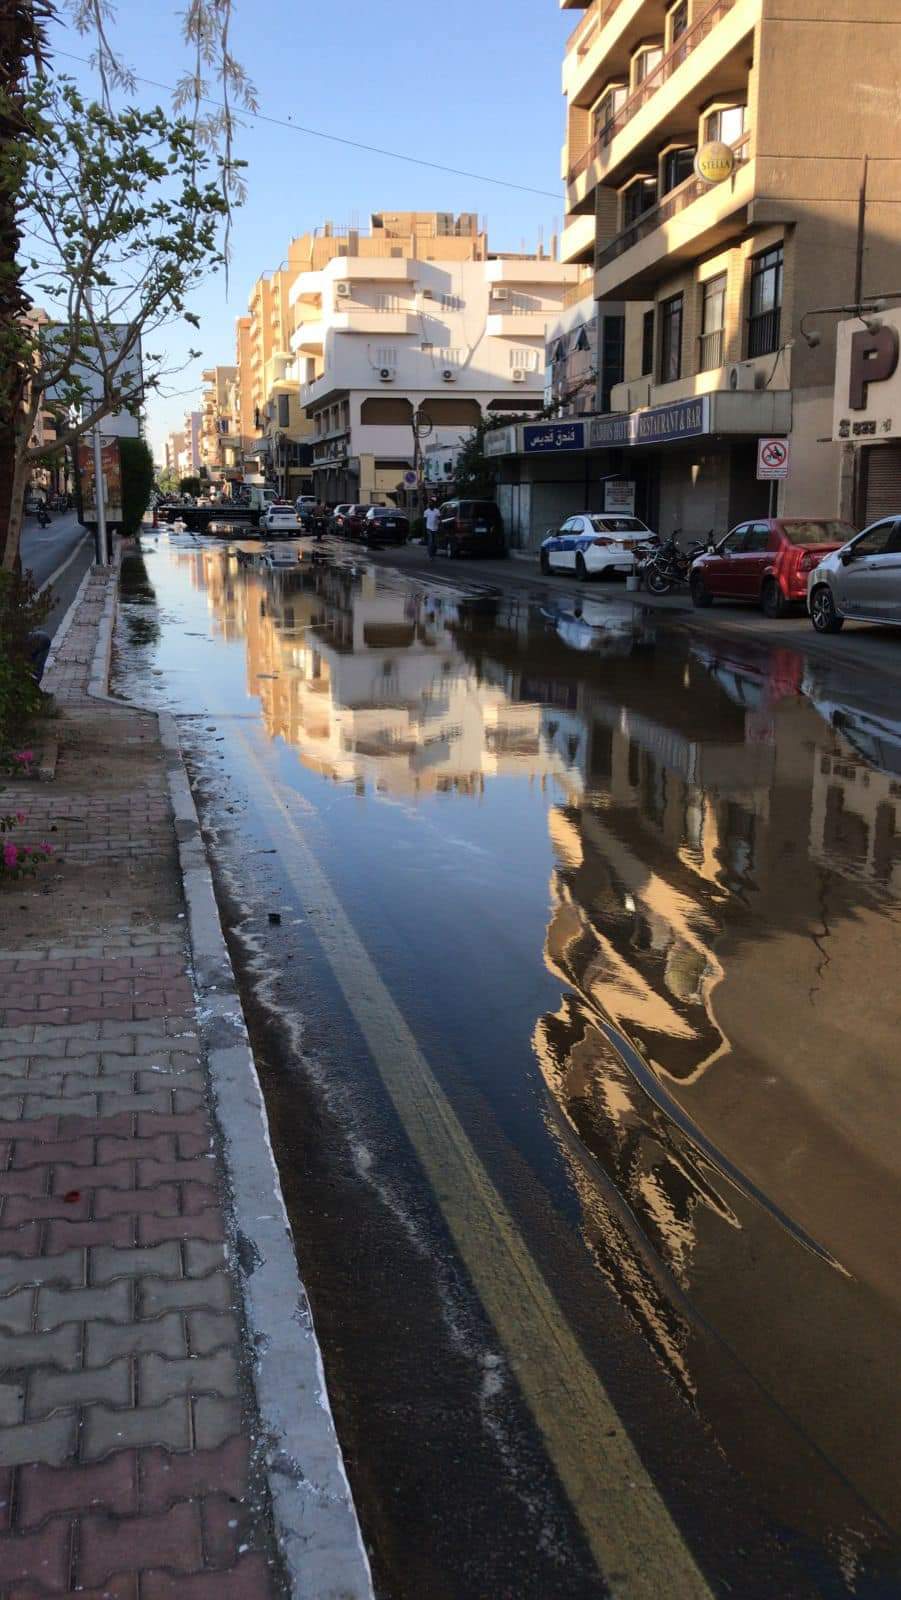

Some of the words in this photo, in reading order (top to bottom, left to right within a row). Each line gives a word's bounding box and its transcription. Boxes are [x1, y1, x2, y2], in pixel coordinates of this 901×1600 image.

[702, 159, 730, 170] STELLA
[849, 325, 899, 411] P
[639, 410, 679, 436] RESTAURANT
[687, 406, 701, 429] BAR
[555, 426, 575, 446] فندق
